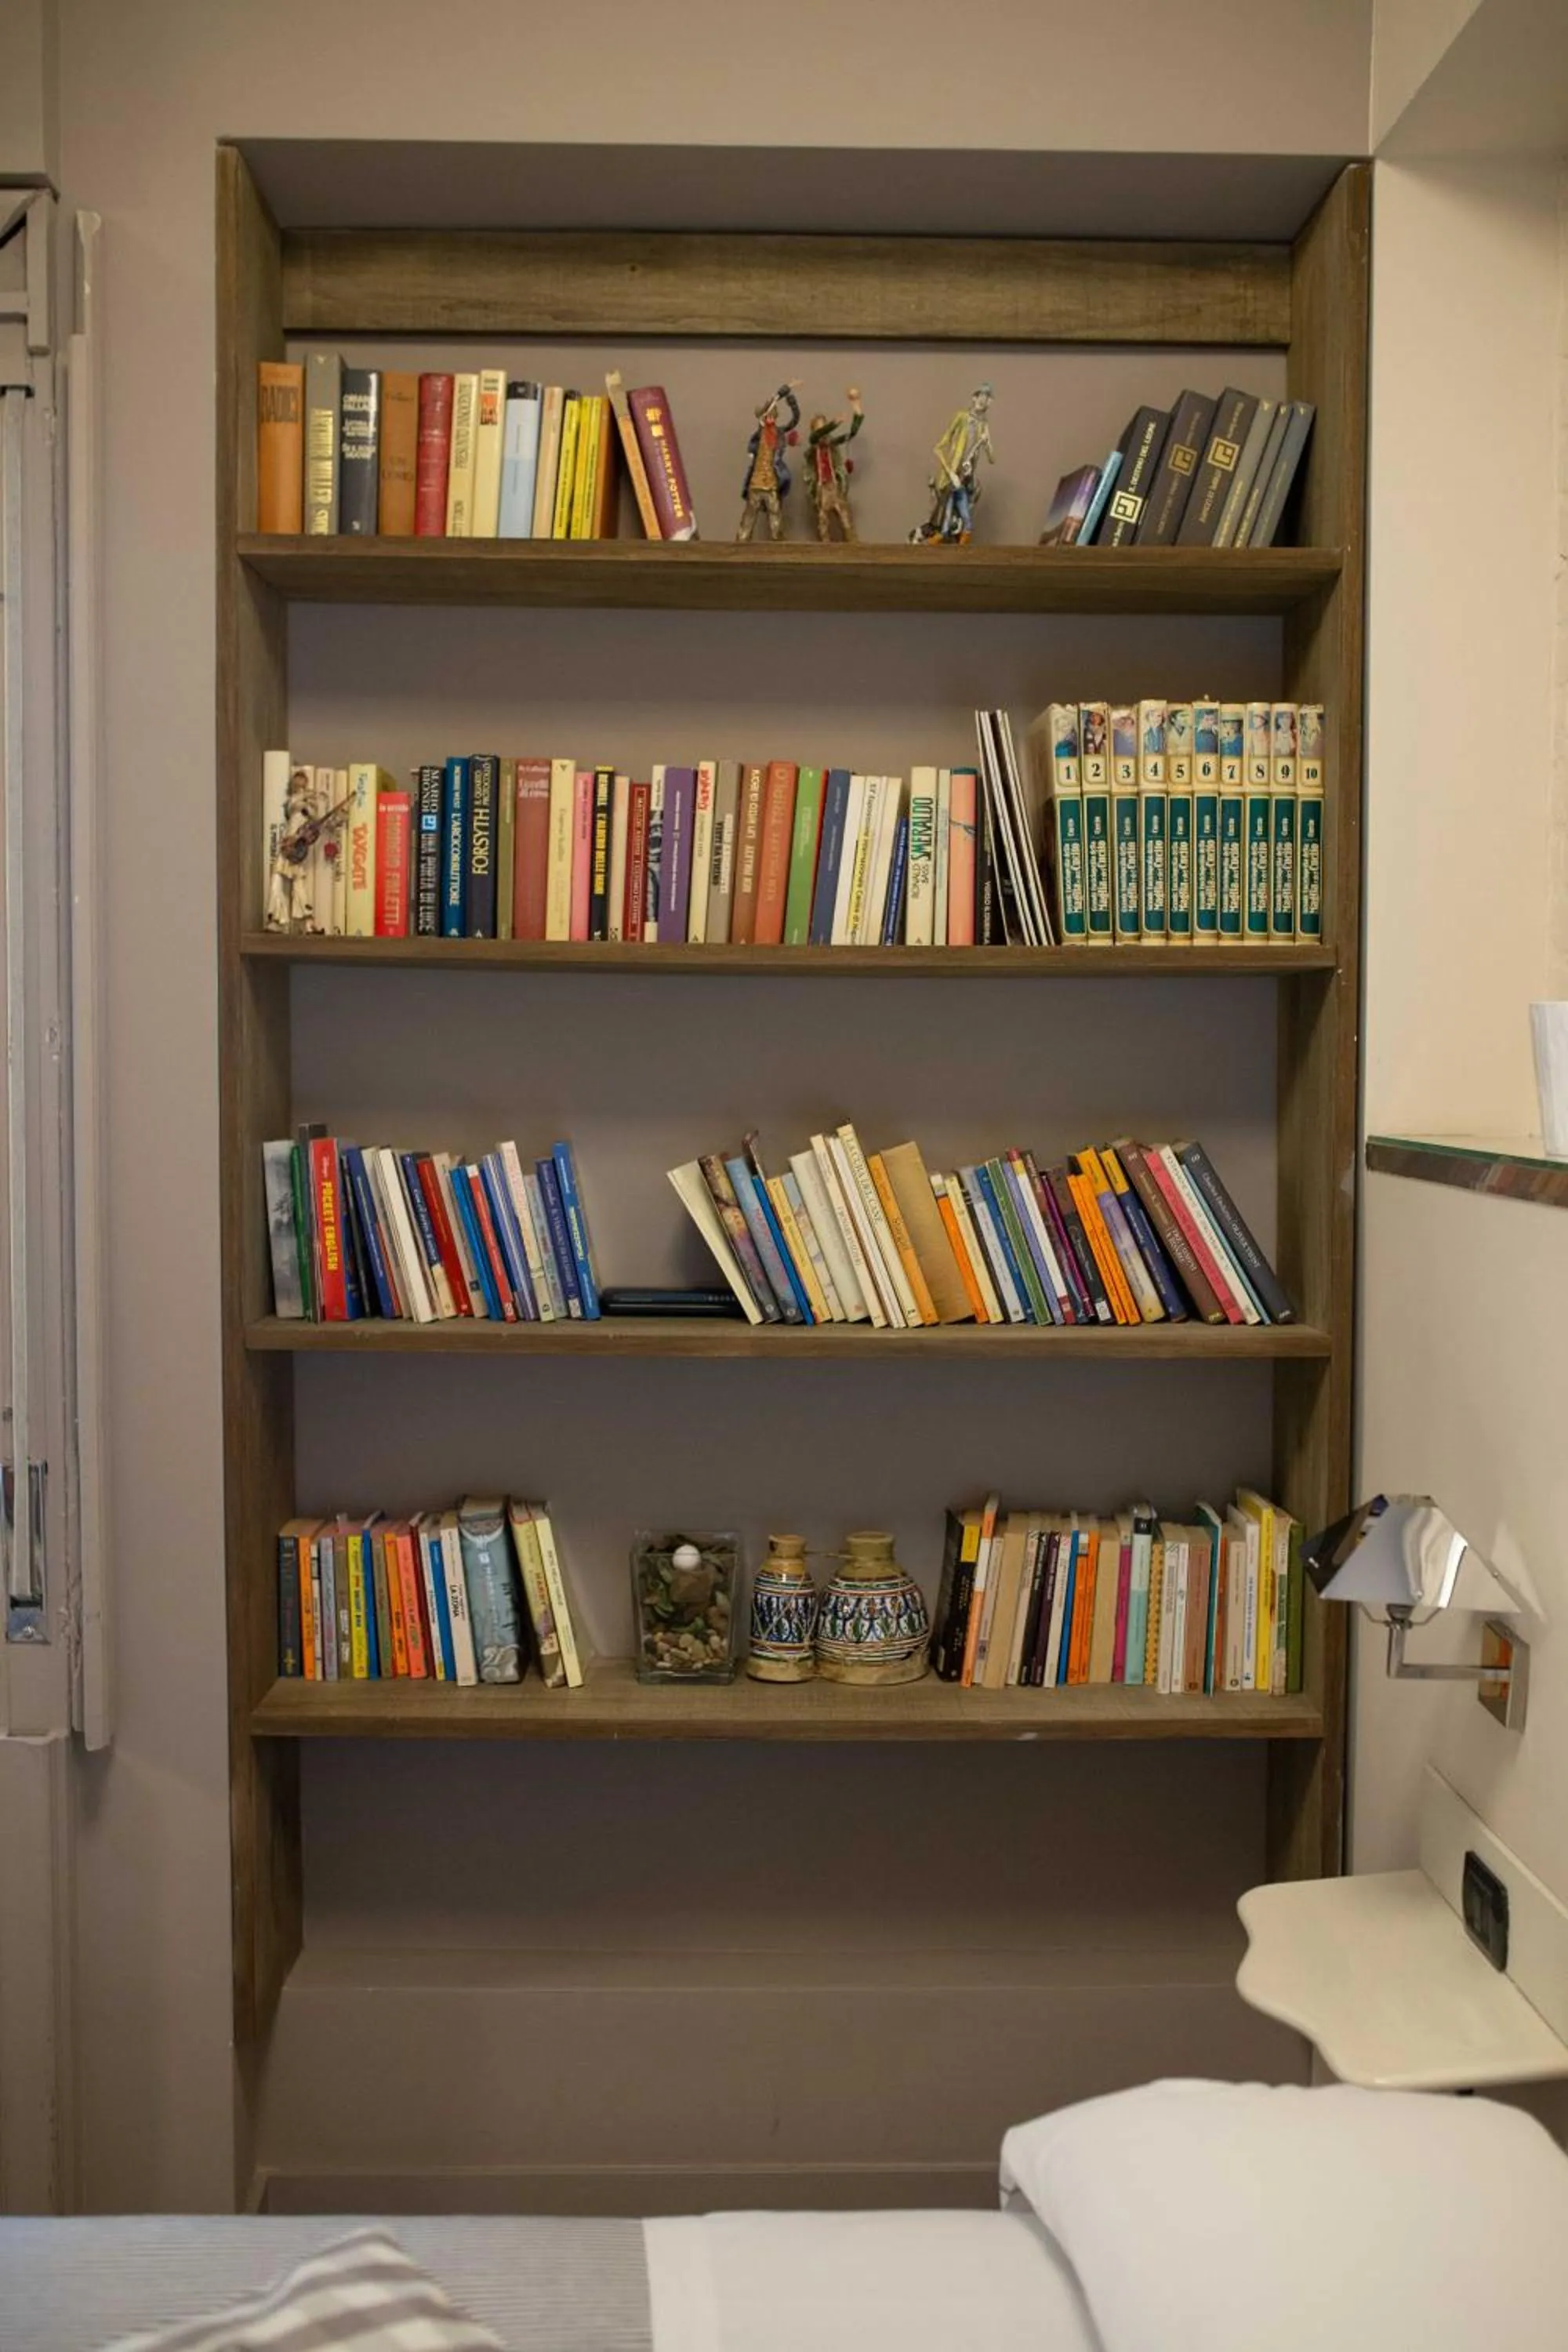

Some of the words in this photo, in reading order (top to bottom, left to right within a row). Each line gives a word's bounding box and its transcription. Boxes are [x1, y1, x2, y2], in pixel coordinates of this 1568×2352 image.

[660, 441, 672, 476] HARRY
[668, 475, 683, 517] POTTER
[1065, 765, 1072, 779] 1
[1091, 763, 1101, 777] 2
[1122, 764, 1131, 779] 3
[1150, 762, 1159, 776] 4
[1176, 764, 1185, 779] 5
[1203, 763, 1211, 776] 6
[1227, 765, 1236, 779] 7
[1256, 764, 1265, 778] 8
[1281, 764, 1290, 779] 9
[1305, 768, 1317, 779] 10
[422, 769, 430, 812] BIONDI
[430, 769, 440, 813] MARIO
[771, 768, 789, 826] TRIPLO
[472, 809, 489, 875] FORSYTH
[911, 797, 933, 862] SMERALDO
[353, 822, 368, 891] TAXGATE
[420, 856, 437, 889] PORTA
[911, 862, 920, 899] RONALD
[920, 863, 929, 884] BASS
[384, 872, 400, 926] FALETTI
[419, 905, 435, 931] LUCE
[321, 1181, 335, 1224] POCKET
[325, 1225, 339, 1272] ENGLISH
